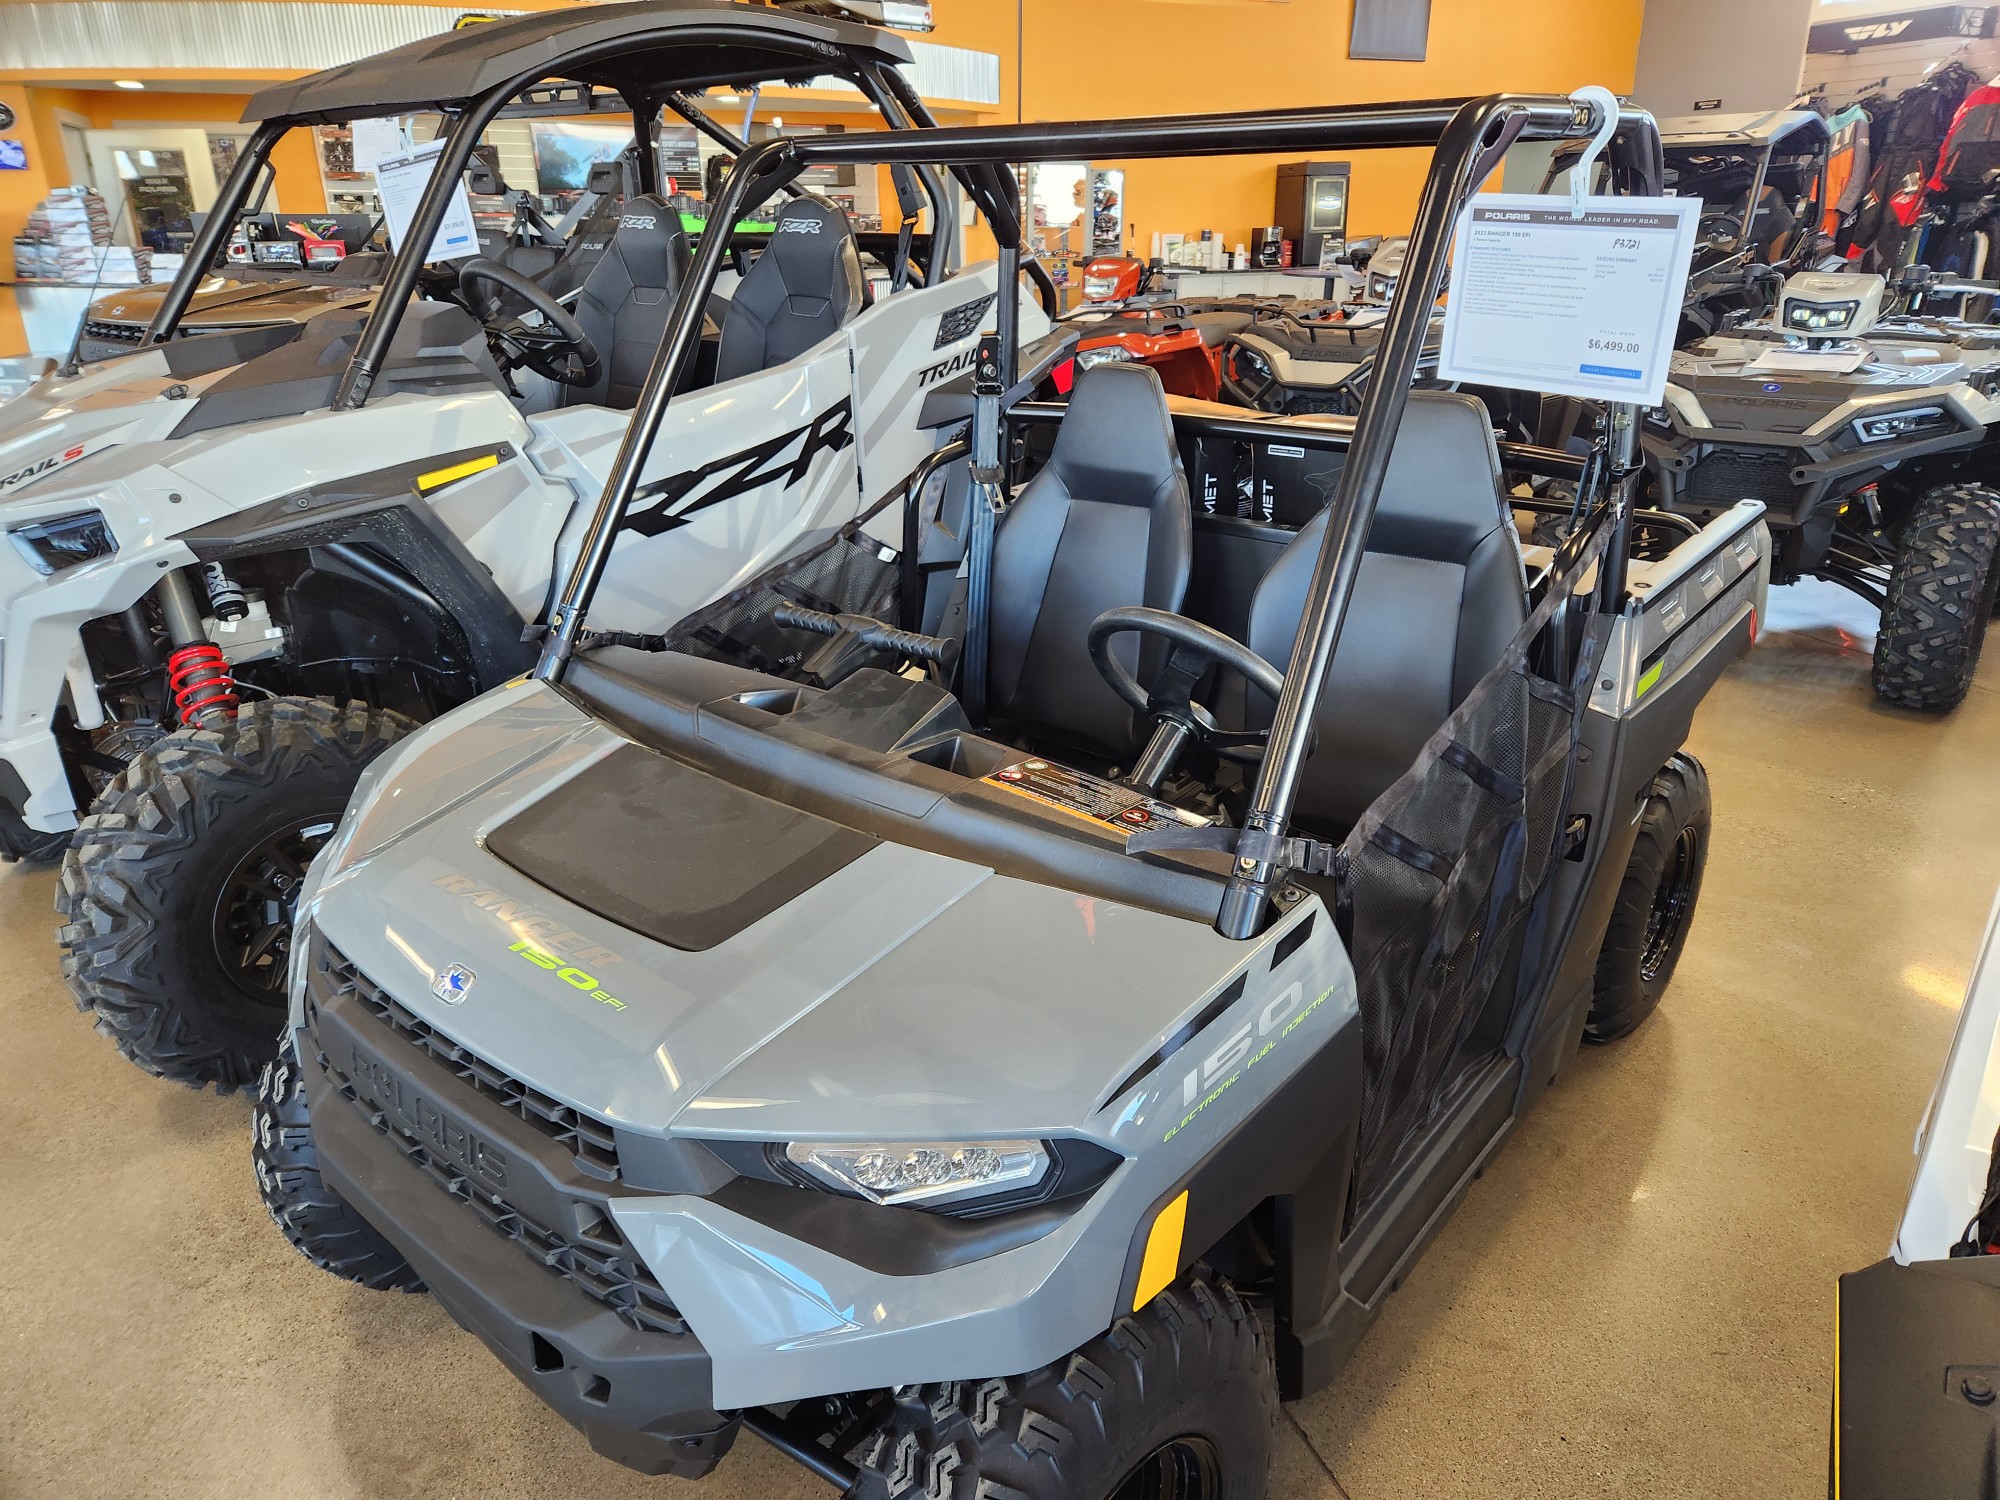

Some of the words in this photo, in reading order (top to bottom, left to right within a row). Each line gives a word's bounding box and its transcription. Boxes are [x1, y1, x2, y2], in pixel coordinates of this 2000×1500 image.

[1844, 20, 1914, 40] FLY
[620, 214, 657, 231] RZR
[1484, 211, 1531, 221] POLARIS
[778, 217, 823, 235] RZR
[1612, 238, 1641, 250] P3721
[1300, 349, 1353, 361] POLARIS
[1588, 339, 1640, 353] $6,499.00
[918, 347, 977, 388] TRAIL
[1723, 397, 1808, 410] POLARIS
[62, 443, 85, 462] S
[619, 394, 855, 538] RZR
[431, 873, 624, 969] RANGER
[507, 940, 599, 991] 150
[590, 989, 628, 1012] EFI
[1183, 980, 1303, 1108] 150
[1163, 1070, 1241, 1142] ELECTRONIC
[1247, 1040, 1277, 1069] FUEL
[1281, 985, 1334, 1038] INJECTION
[351, 1044, 509, 1191] POLARIS
